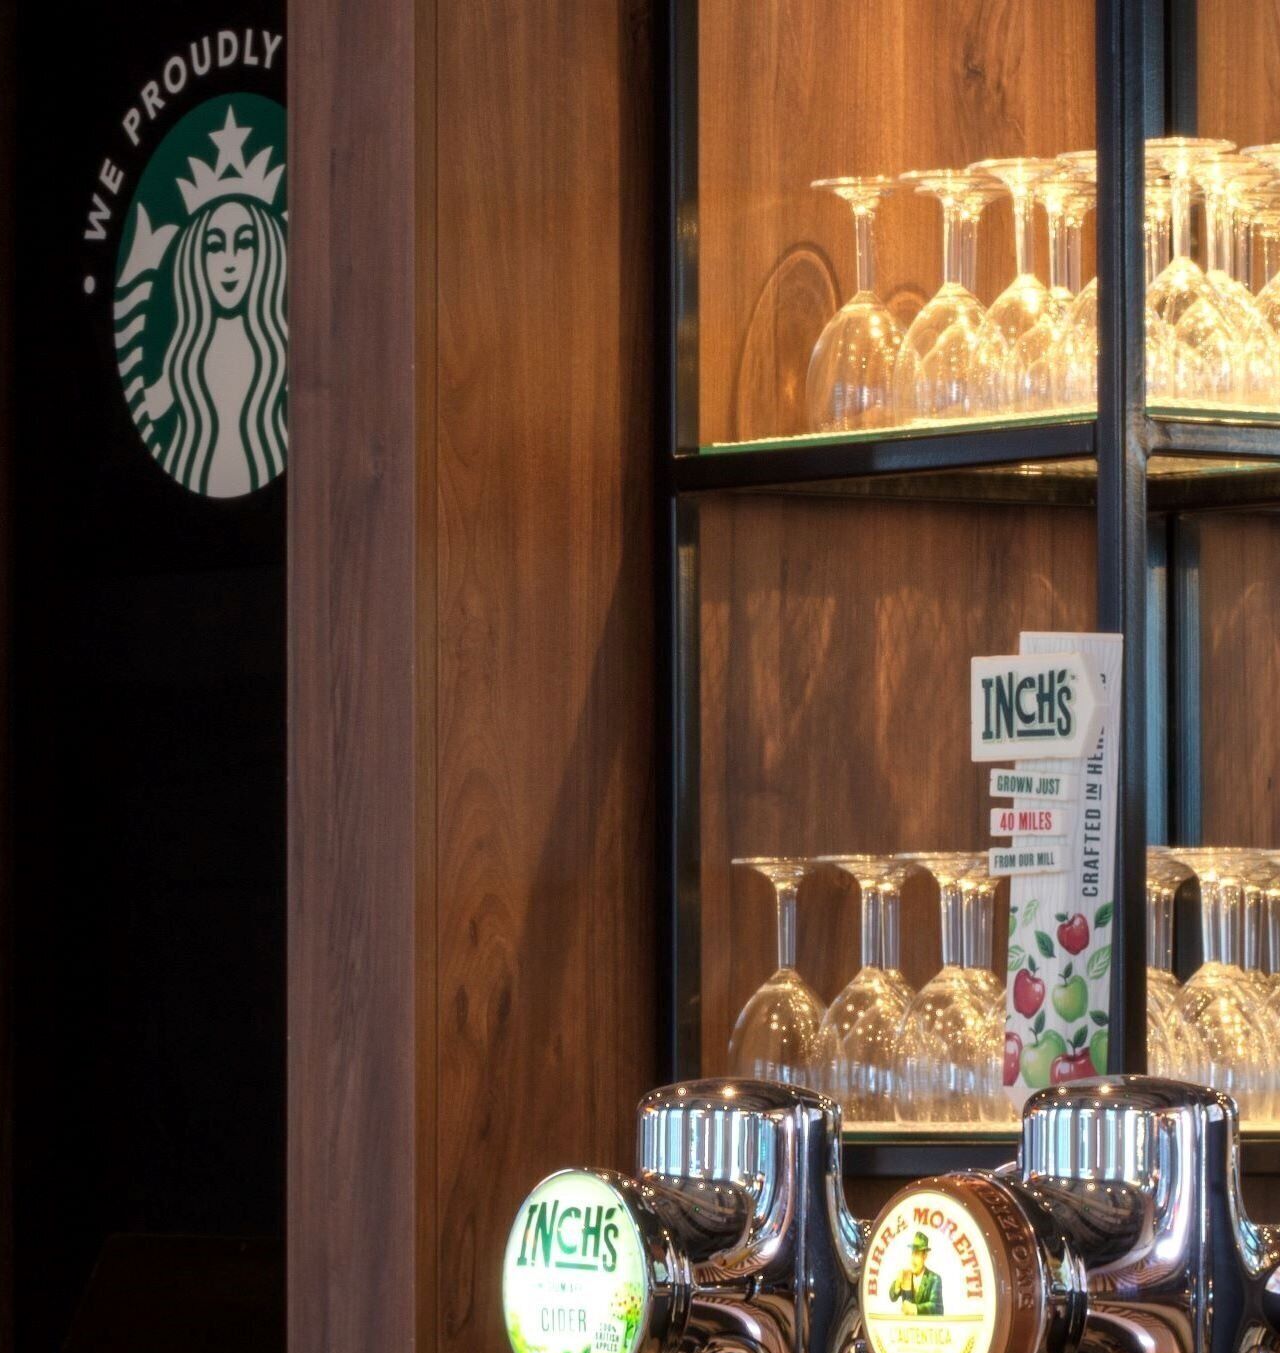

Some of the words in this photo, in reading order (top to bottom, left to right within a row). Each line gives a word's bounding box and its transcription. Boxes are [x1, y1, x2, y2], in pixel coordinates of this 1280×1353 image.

[84, 157, 125, 240] WE
[122, 28, 283, 146] PROUDLY
[997, 775, 1033, 793] GROWN
[1036, 778, 1061, 795] JUST
[1086, 783, 1102, 800] IN
[1000, 811, 1015, 831] 40
[1019, 811, 1052, 831] MILES
[994, 854, 1016, 868] FROM
[1019, 853, 1034, 866] OUR
[1037, 852, 1054, 865] MILL
[1082, 808, 1101, 897] CRAFTED
[868, 1215, 909, 1296] BIRRA
[913, 1207, 983, 1298] MORETTI
[541, 1308, 587, 1332] CIDER
